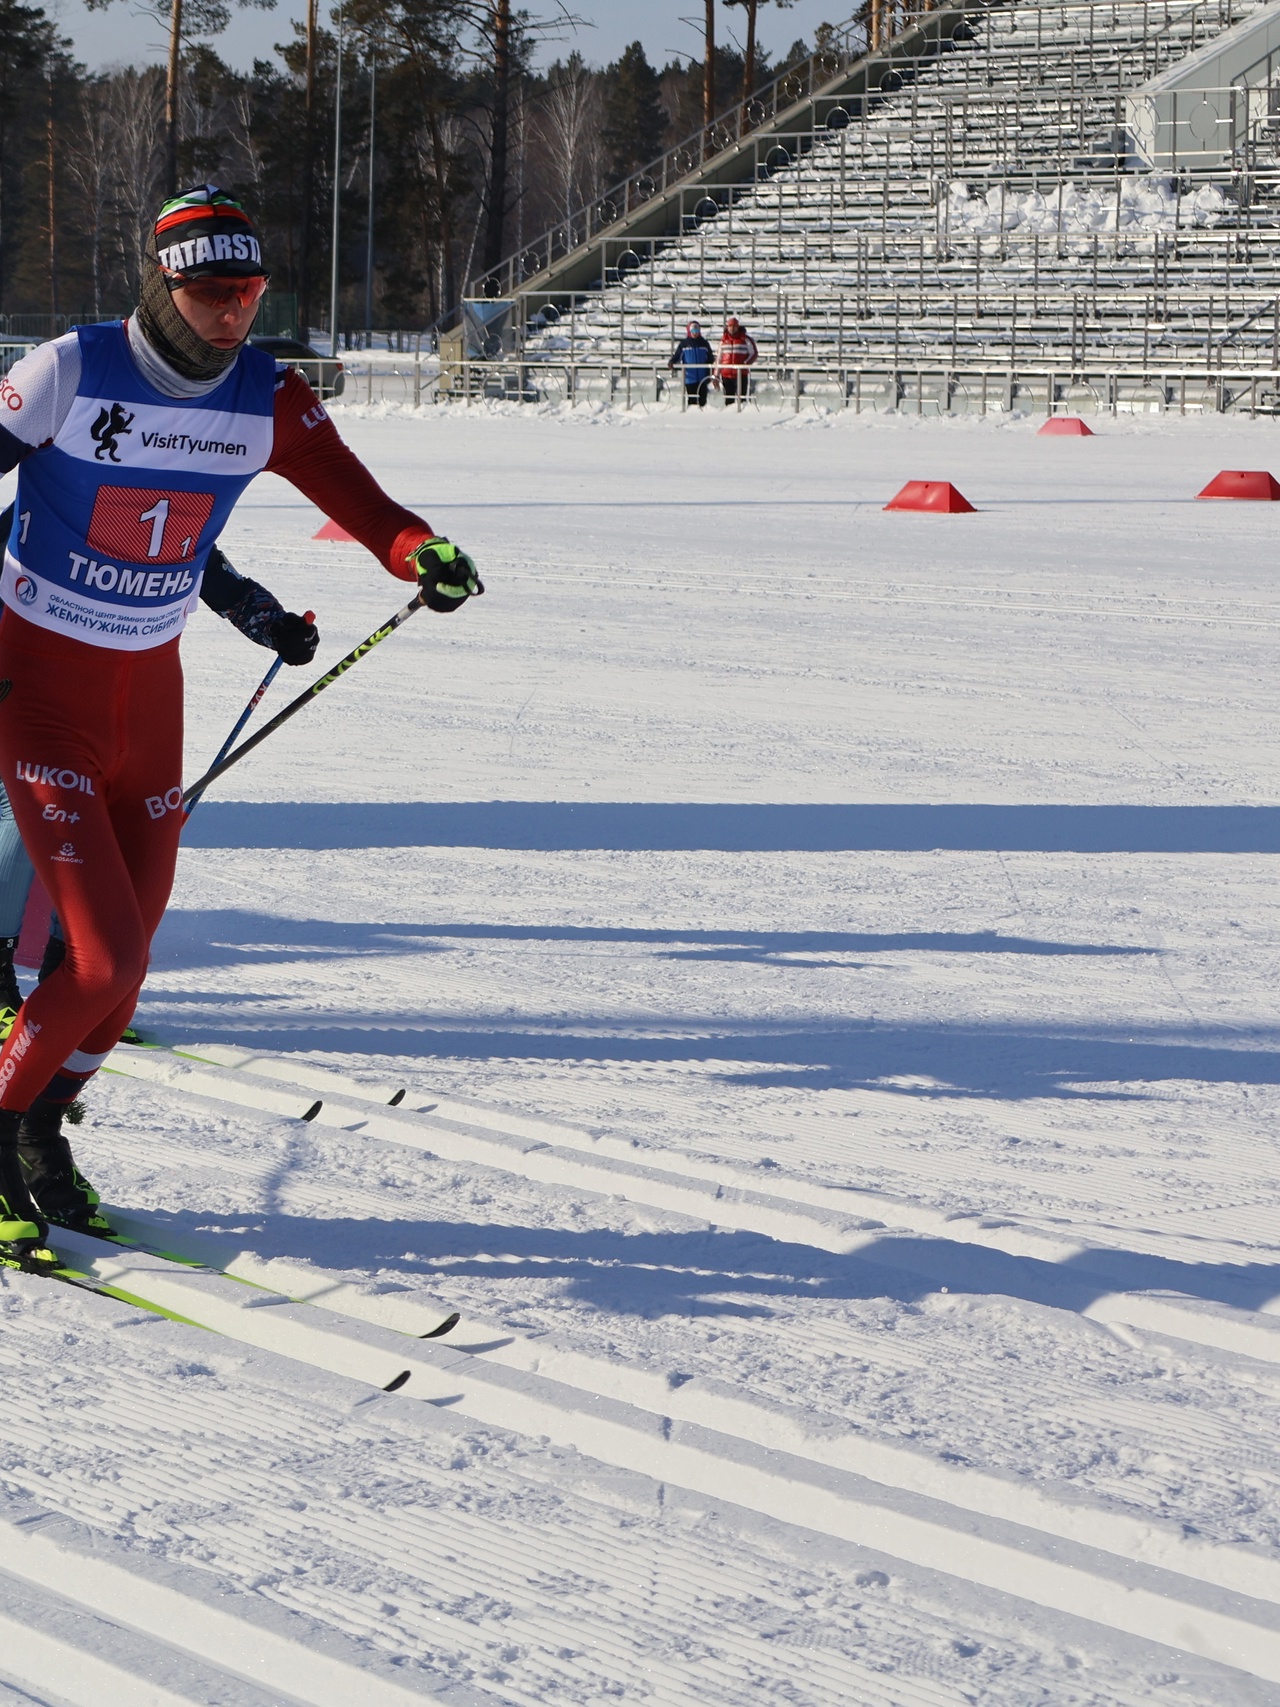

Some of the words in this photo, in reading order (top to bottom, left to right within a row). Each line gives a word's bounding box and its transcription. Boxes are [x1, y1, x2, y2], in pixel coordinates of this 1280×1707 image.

[141, 431, 247, 456] VisitTyumen
[19, 510, 31, 544] 1
[139, 499, 170, 558] 1
[181, 536, 192, 557] 1
[69, 551, 194, 597] ТЮМЕНЬ
[45, 602, 139, 636] ЖЕМЧУЖИНА
[141, 615, 181, 636] СИБИРИ
[49, 594, 94, 615] ОБЛАСТНОЙ
[95, 610, 116, 620] ЦЕНТР
[117, 614, 146, 623] ЗИМНИХ
[146, 614, 166, 623] ВИДОВ
[16, 760, 95, 796] LUKOIL
[50, 855, 84, 864] PHOSAGRO
